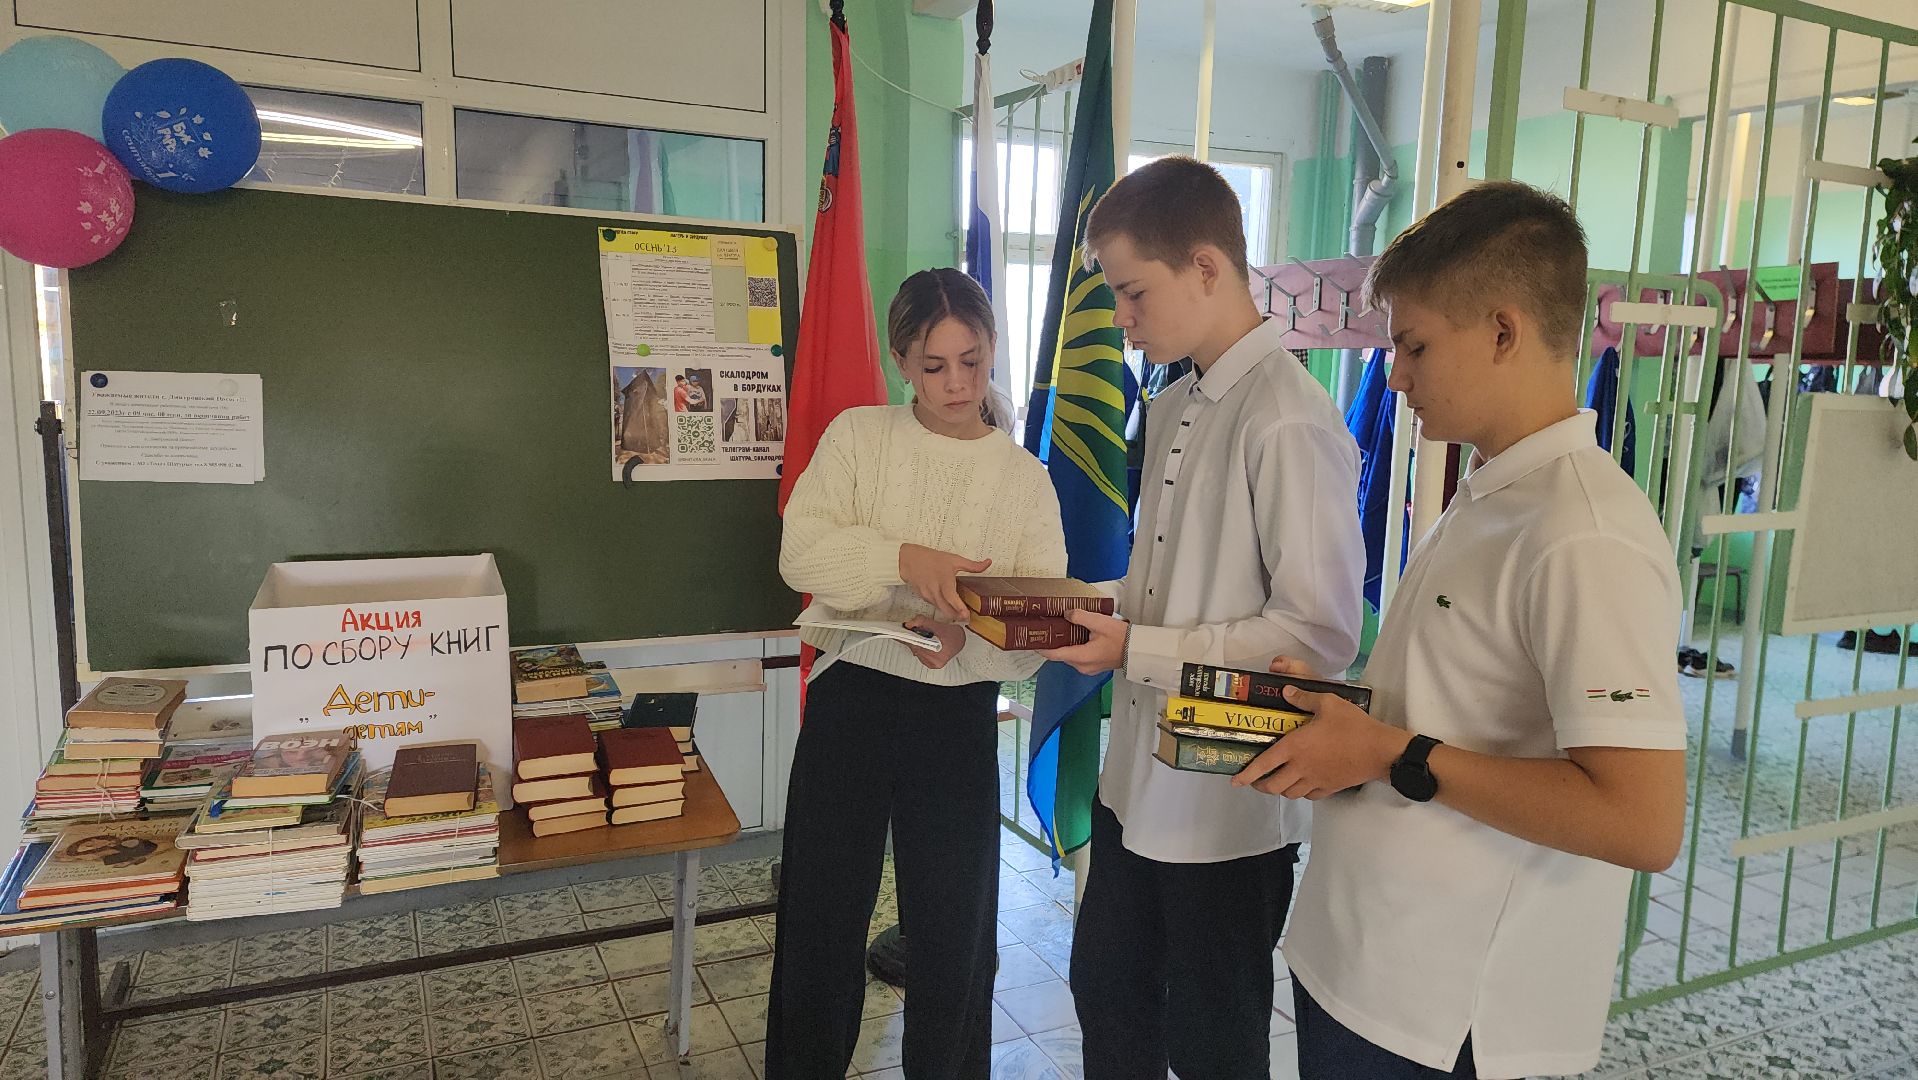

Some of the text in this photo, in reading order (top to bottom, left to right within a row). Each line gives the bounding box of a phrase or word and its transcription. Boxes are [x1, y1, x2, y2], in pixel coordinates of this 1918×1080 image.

[719, 370, 769, 381] СКАЛОДРОМ
[733, 383, 782, 394] В БОРДУКАХ
[340, 607, 423, 633] Акция
[263, 624, 501, 673] ПО СБОРУ КНИГ
[322, 683, 436, 717] Дети-
[342, 719, 424, 751] детям
